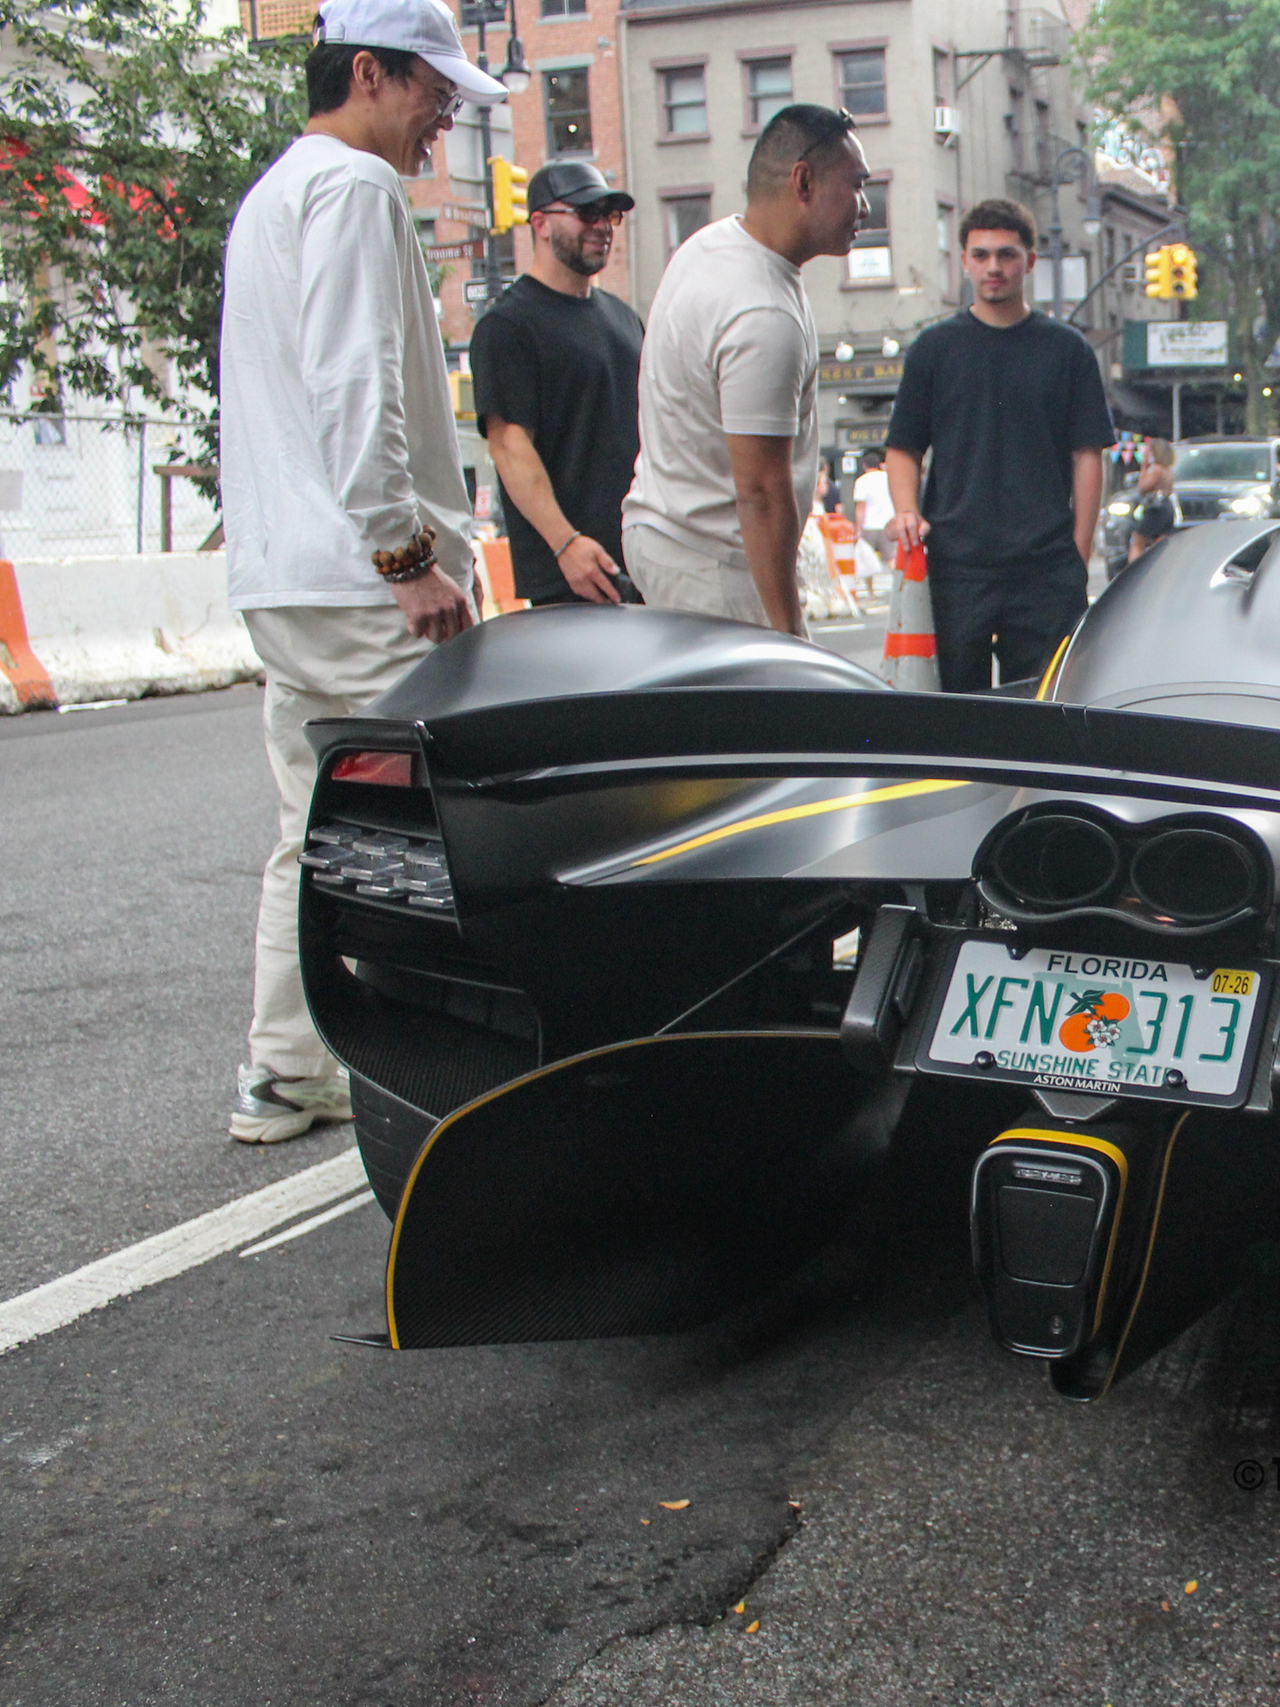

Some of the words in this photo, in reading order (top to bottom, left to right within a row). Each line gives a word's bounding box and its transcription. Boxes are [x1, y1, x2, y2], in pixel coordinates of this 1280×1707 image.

[1046, 954, 1168, 982] FLORIDA
[1213, 974, 1250, 994] 07-26
[949, 972, 1065, 1047] XFN
[1125, 989, 1241, 1062] 313
[997, 1050, 1099, 1078] SUNSHINE
[1033, 1074, 1075, 1087] ASTON
[1074, 1078, 1121, 1093] MARTIN
